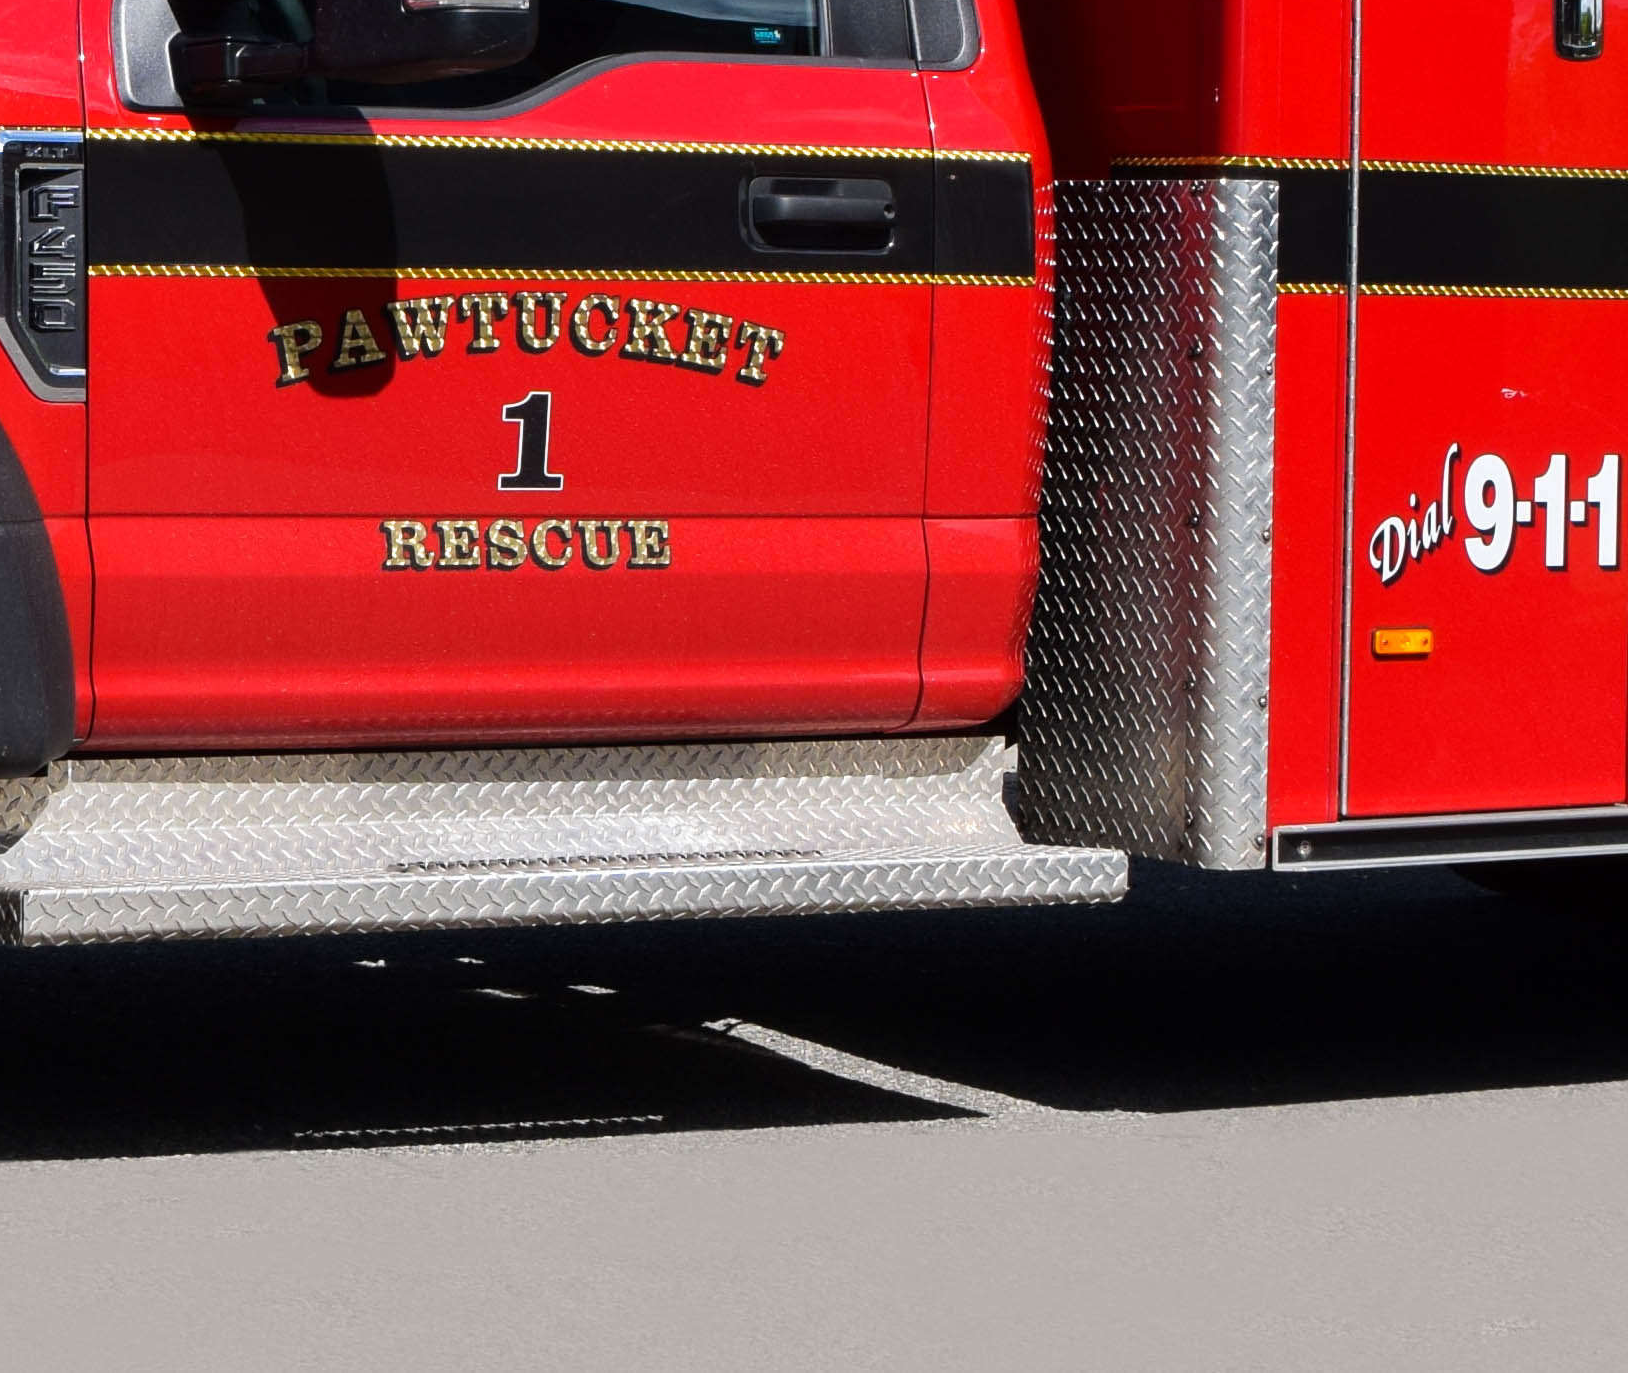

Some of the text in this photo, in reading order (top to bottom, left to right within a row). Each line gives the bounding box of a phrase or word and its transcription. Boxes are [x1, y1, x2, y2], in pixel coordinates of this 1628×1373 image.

[267, 290, 786, 388] PAWTUCKET
[497, 390, 565, 492] 1
[380, 518, 672, 572] RESCUE
[1368, 442, 1621, 583] Dial 9-1-1
